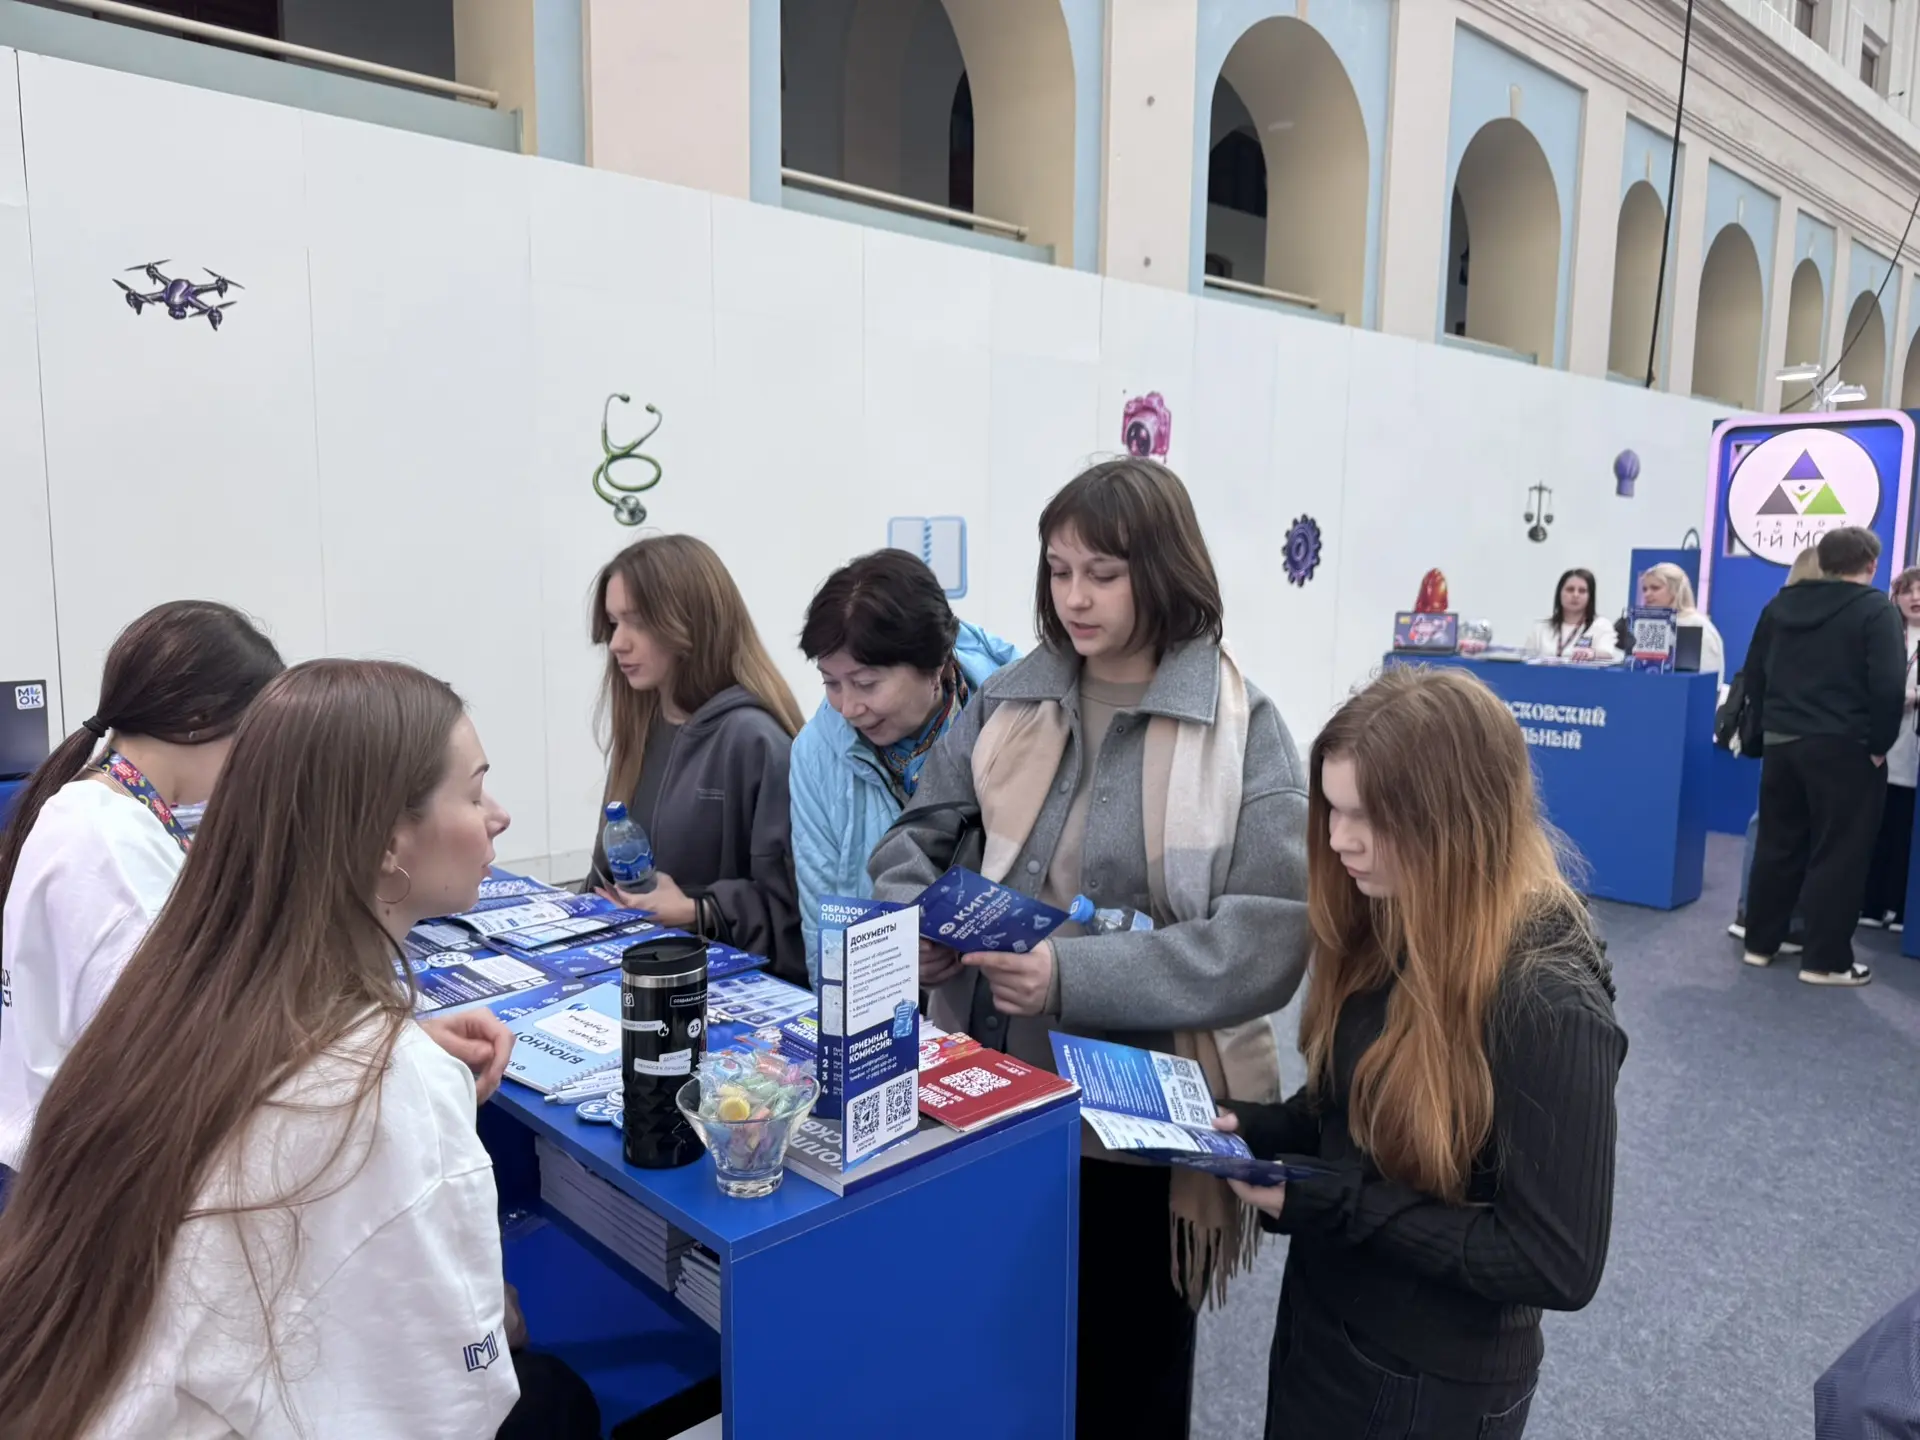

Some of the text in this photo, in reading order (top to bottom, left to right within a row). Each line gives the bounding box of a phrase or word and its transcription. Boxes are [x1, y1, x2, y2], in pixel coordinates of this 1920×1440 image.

[1504, 700, 1607, 728] СКОВСКИЙ
[953, 885, 1000, 921] КИГМ
[850, 923, 897, 947] ДОКУМЕНТЫ
[690, 1023, 700, 1033] 23
[849, 1029, 888, 1054] ПРИЕМНАЯ
[823, 1046, 829, 1055] 1
[849, 1038, 892, 1063] КОМИССИЯ:
[822, 1059, 829, 1068] 2
[822, 1072, 828, 1080] 3
[821, 1086, 829, 1095] 4
